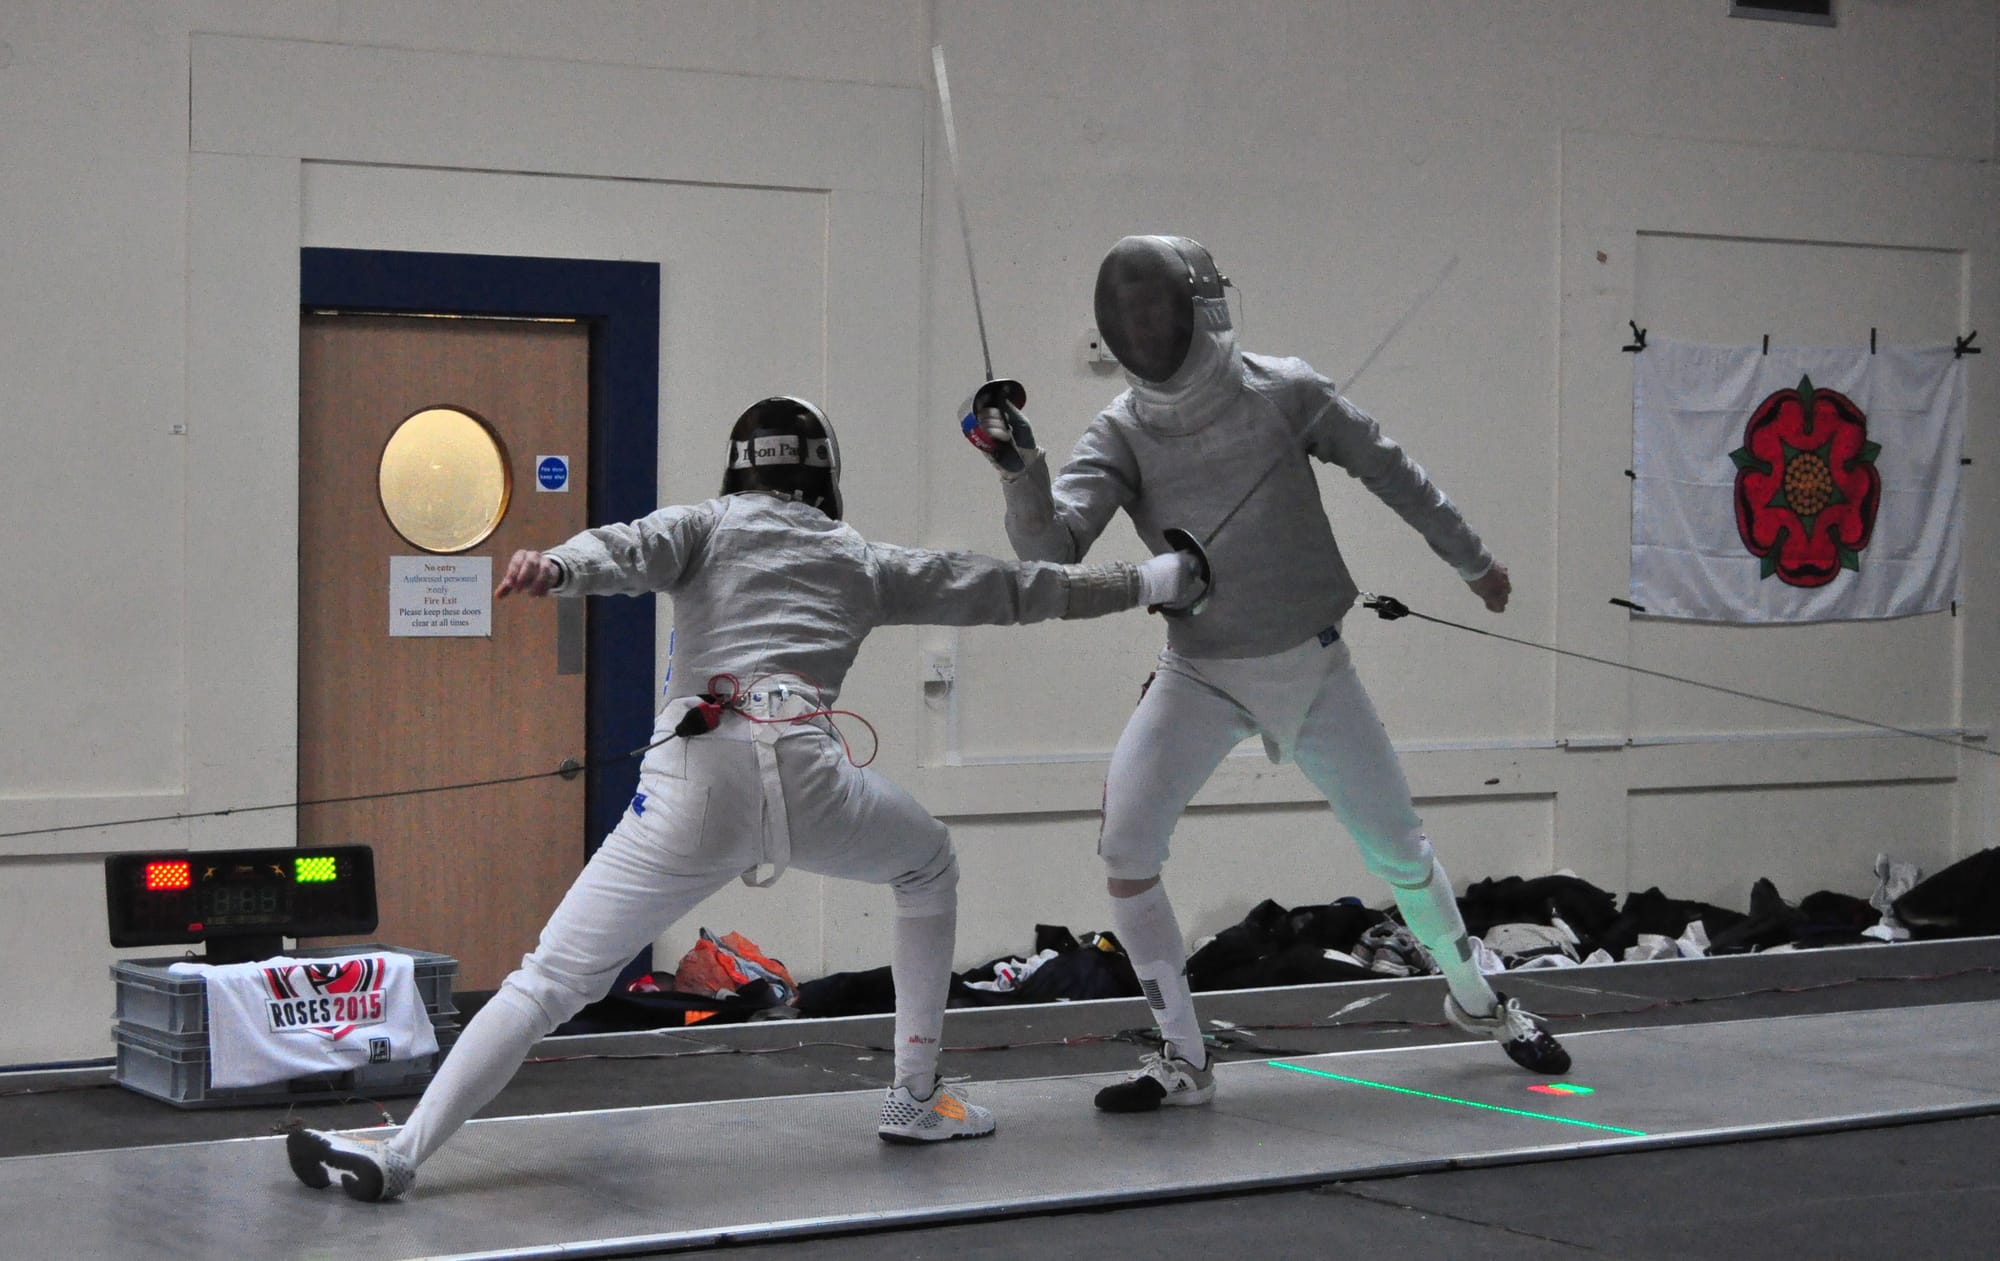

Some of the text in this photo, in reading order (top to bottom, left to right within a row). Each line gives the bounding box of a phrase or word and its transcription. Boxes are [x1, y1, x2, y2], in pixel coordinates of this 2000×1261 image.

[743, 447, 775, 460] Lon
[437, 564, 456, 573] entry
[444, 575, 478, 584] personnel
[432, 587, 448, 595] only
[424, 597, 457, 605] Fire Exit
[400, 608, 482, 618] Please keep these doors
[412, 619, 429, 627] clear
[440, 619, 449, 627] all
[450, 619, 469, 627] times
[270, 994, 381, 1027] ROSES 2015
